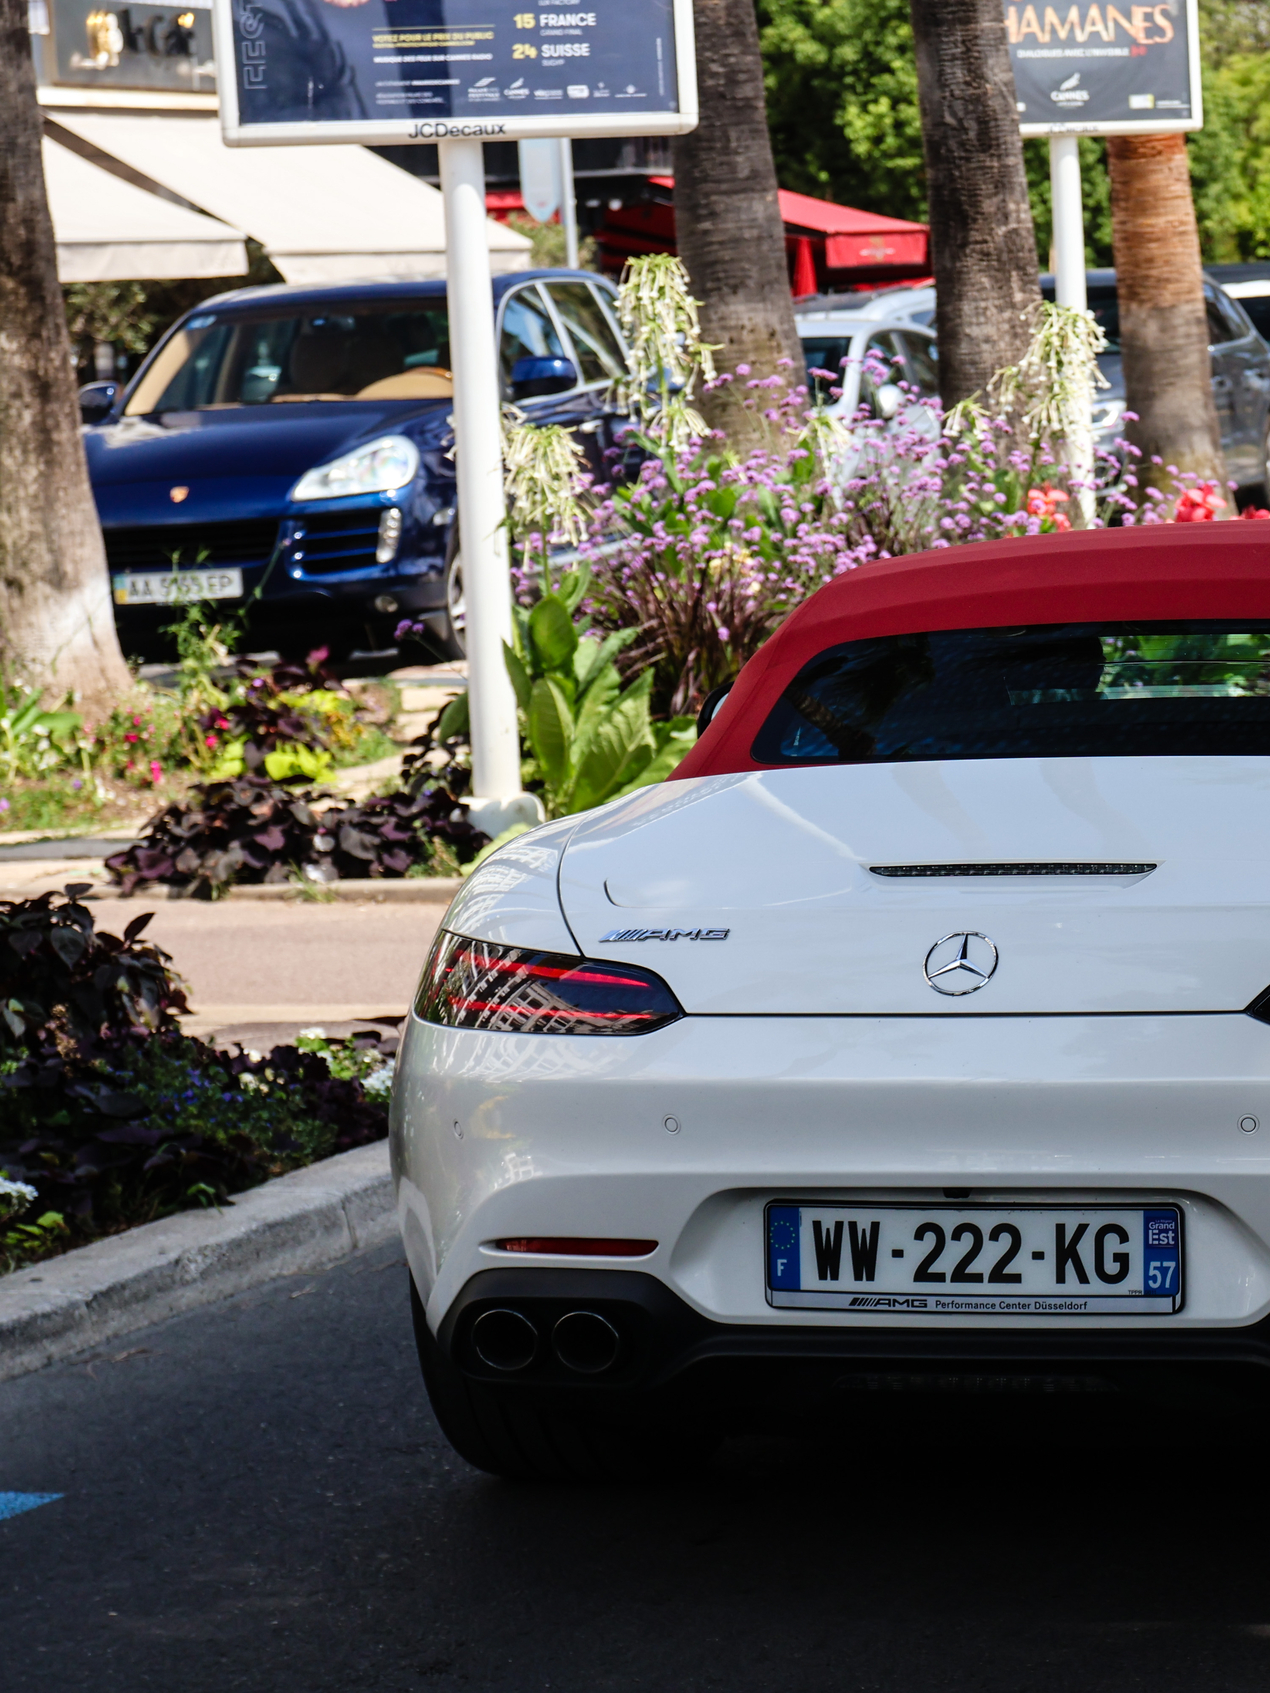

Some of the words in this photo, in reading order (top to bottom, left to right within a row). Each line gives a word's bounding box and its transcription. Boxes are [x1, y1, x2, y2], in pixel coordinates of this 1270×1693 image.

[513, 13, 536, 29] 15
[540, 12, 597, 27] FRANCE
[512, 43, 538, 60] 24
[541, 43, 591, 58] SUISSE
[408, 123, 506, 139] JCDecaux
[129, 580, 152, 598] AA
[637, 928, 730, 942] AMG
[1148, 1221, 1175, 1230] Grand
[1148, 1230, 1175, 1245] Est
[812, 1219, 1130, 1285] WW-222-KG
[776, 1260, 788, 1277] F
[1148, 1261, 1176, 1289] 57
[877, 1298, 928, 1308] AMG
[934, 1300, 997, 1311] Performance
[998, 1301, 1031, 1311] Center
[1034, 1300, 1088, 1311] Düsseldorf
